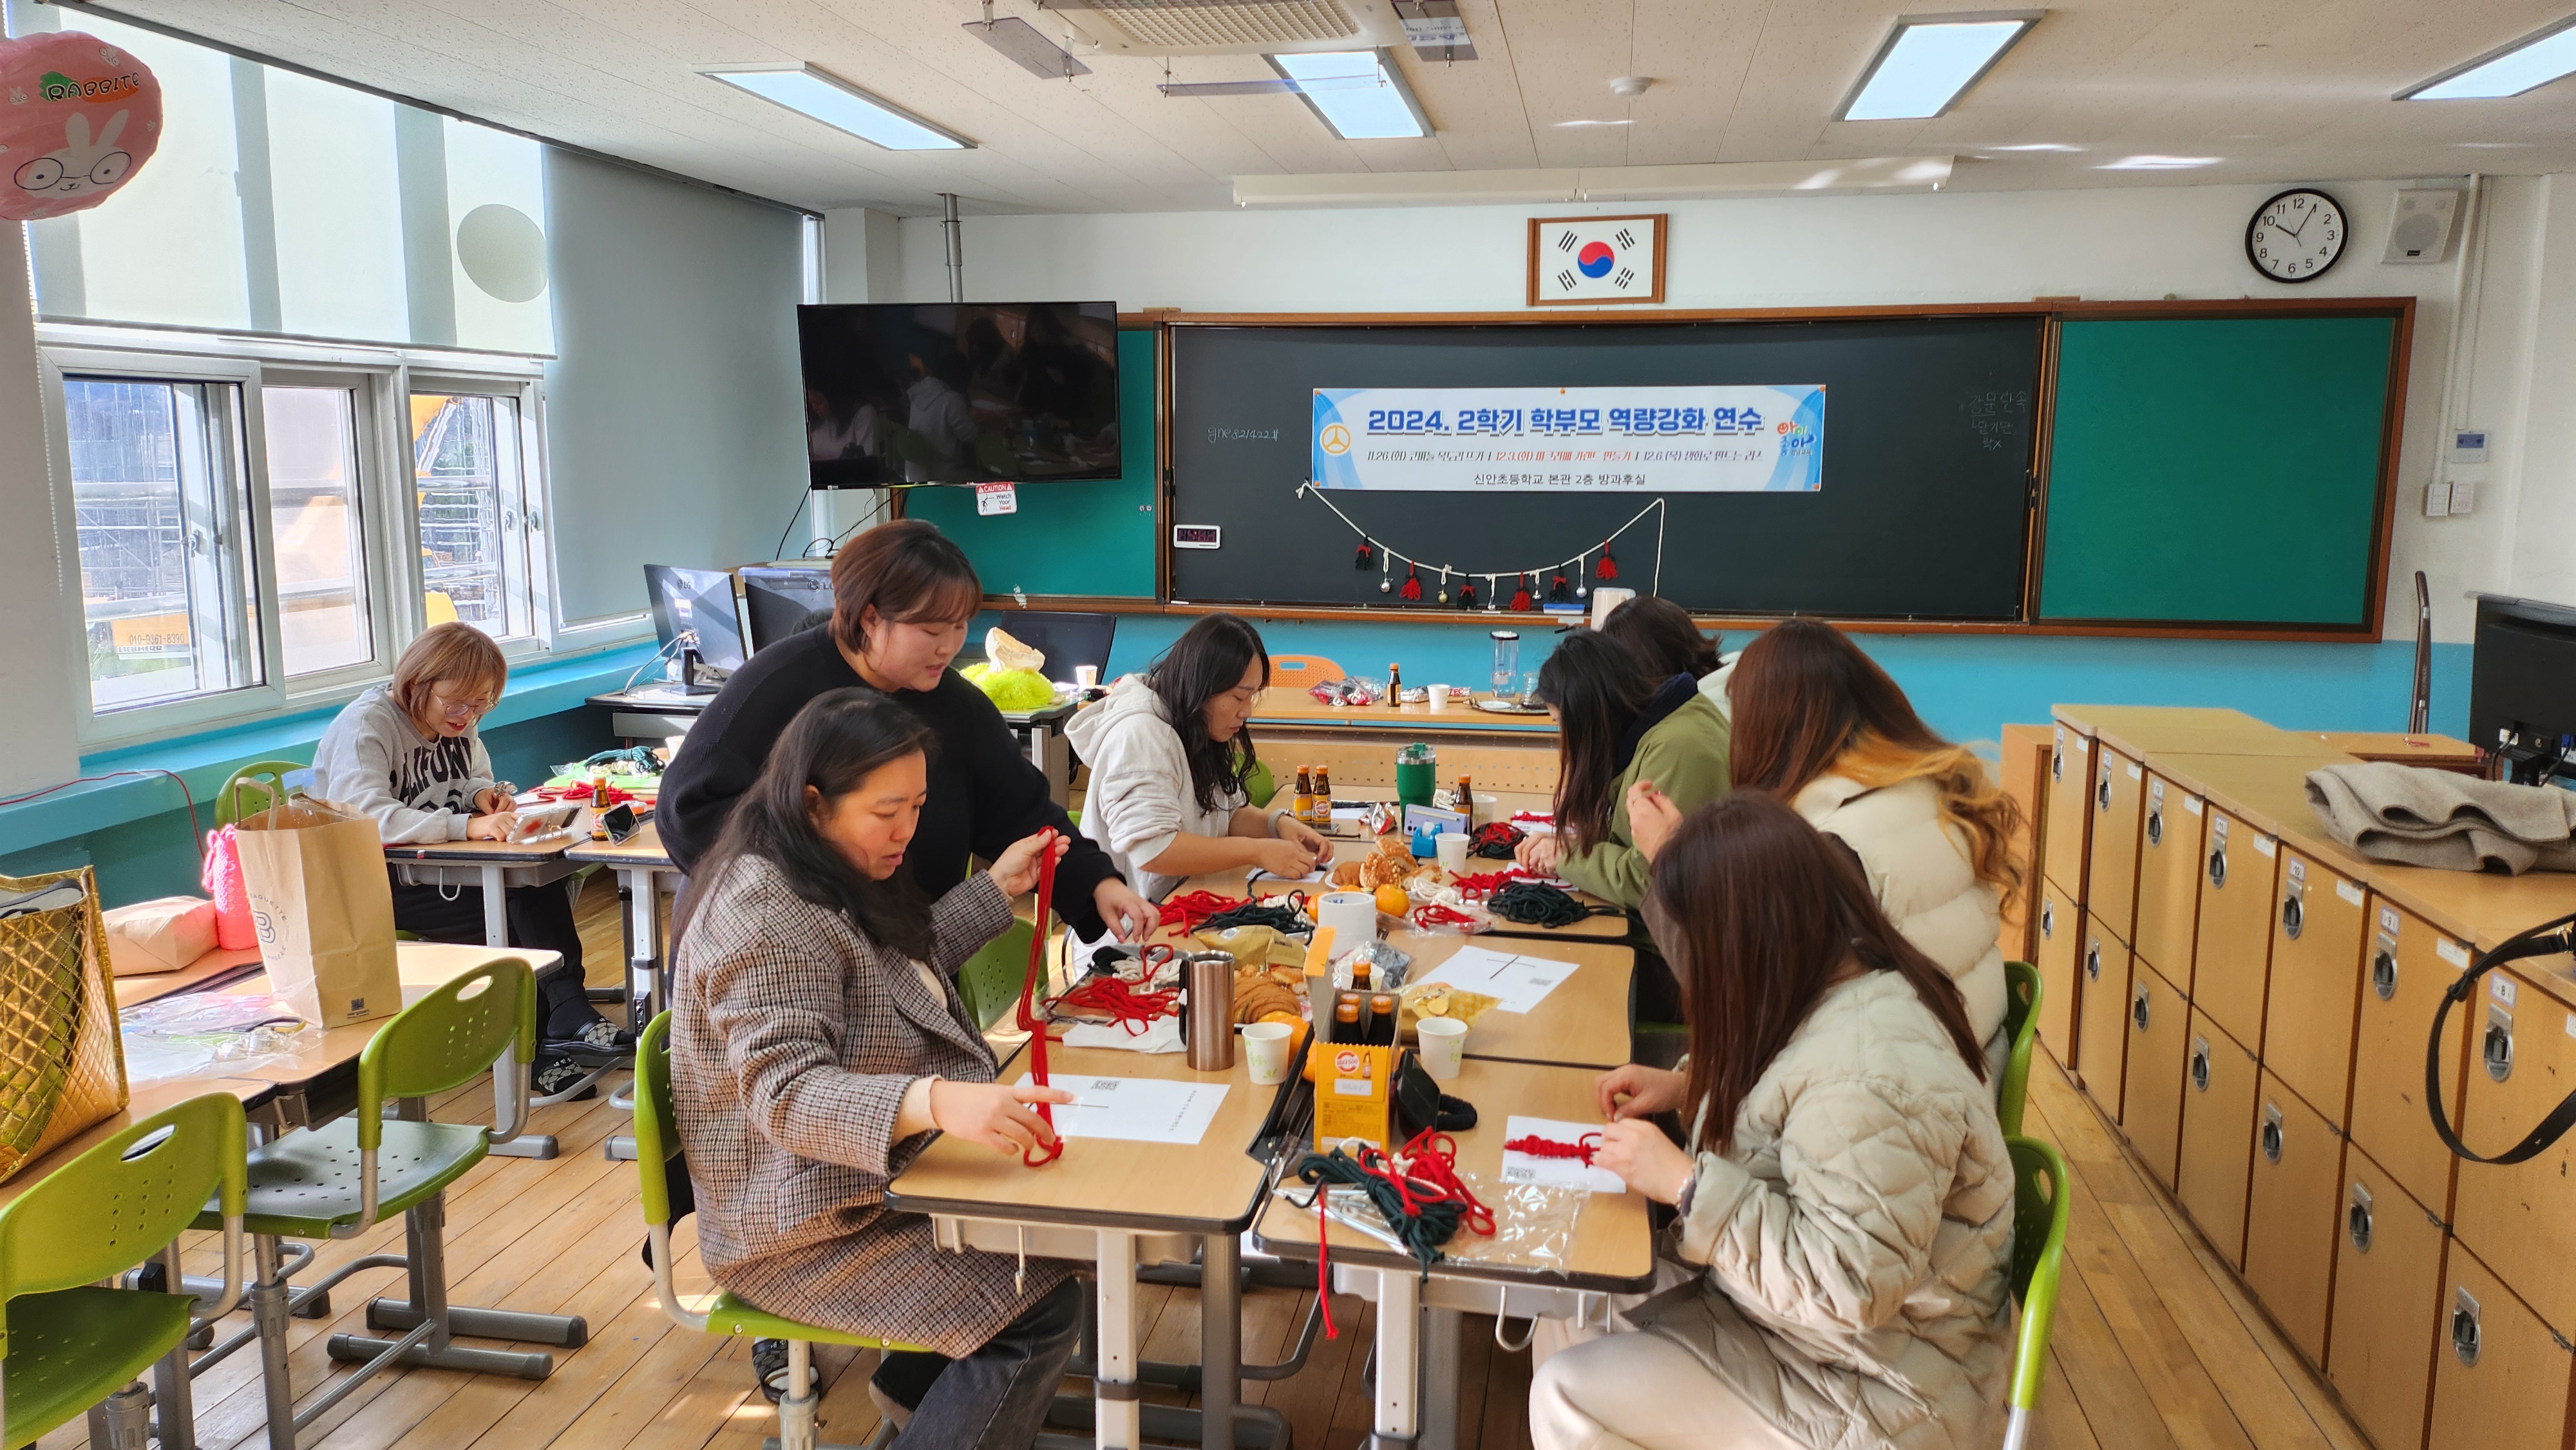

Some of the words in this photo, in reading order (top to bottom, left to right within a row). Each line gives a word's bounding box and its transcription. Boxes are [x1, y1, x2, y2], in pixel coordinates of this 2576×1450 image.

[2277, 204, 2286, 214] 11
[2293, 198, 2305, 209] 12
[2263, 216, 2275, 226] 10
[2323, 214, 2331, 225] 2
[2256, 232, 2264, 243] 9
[2327, 230, 2335, 240] 3
[2259, 248, 2268, 258] 8
[2318, 246, 2327, 257] 4
[2272, 259, 2279, 270] 7
[2287, 263, 2296, 273] 6
[2305, 258, 2313, 268] 5
[1368, 410, 1451, 434] 2024.
[1457, 408, 1524, 435] 2학기
[1530, 408, 1602, 435] 학부모
[1609, 407, 1707, 435] 역량강화
[1714, 406, 1765, 435] 연수
[1474, 474, 1544, 485] 신안초등학교
[1548, 474, 1571, 485] 본관
[1575, 474, 1594, 485] 2층
[1598, 474, 1645, 485] 방과후실
[129, 633, 185, 645] 010-9361-8390
